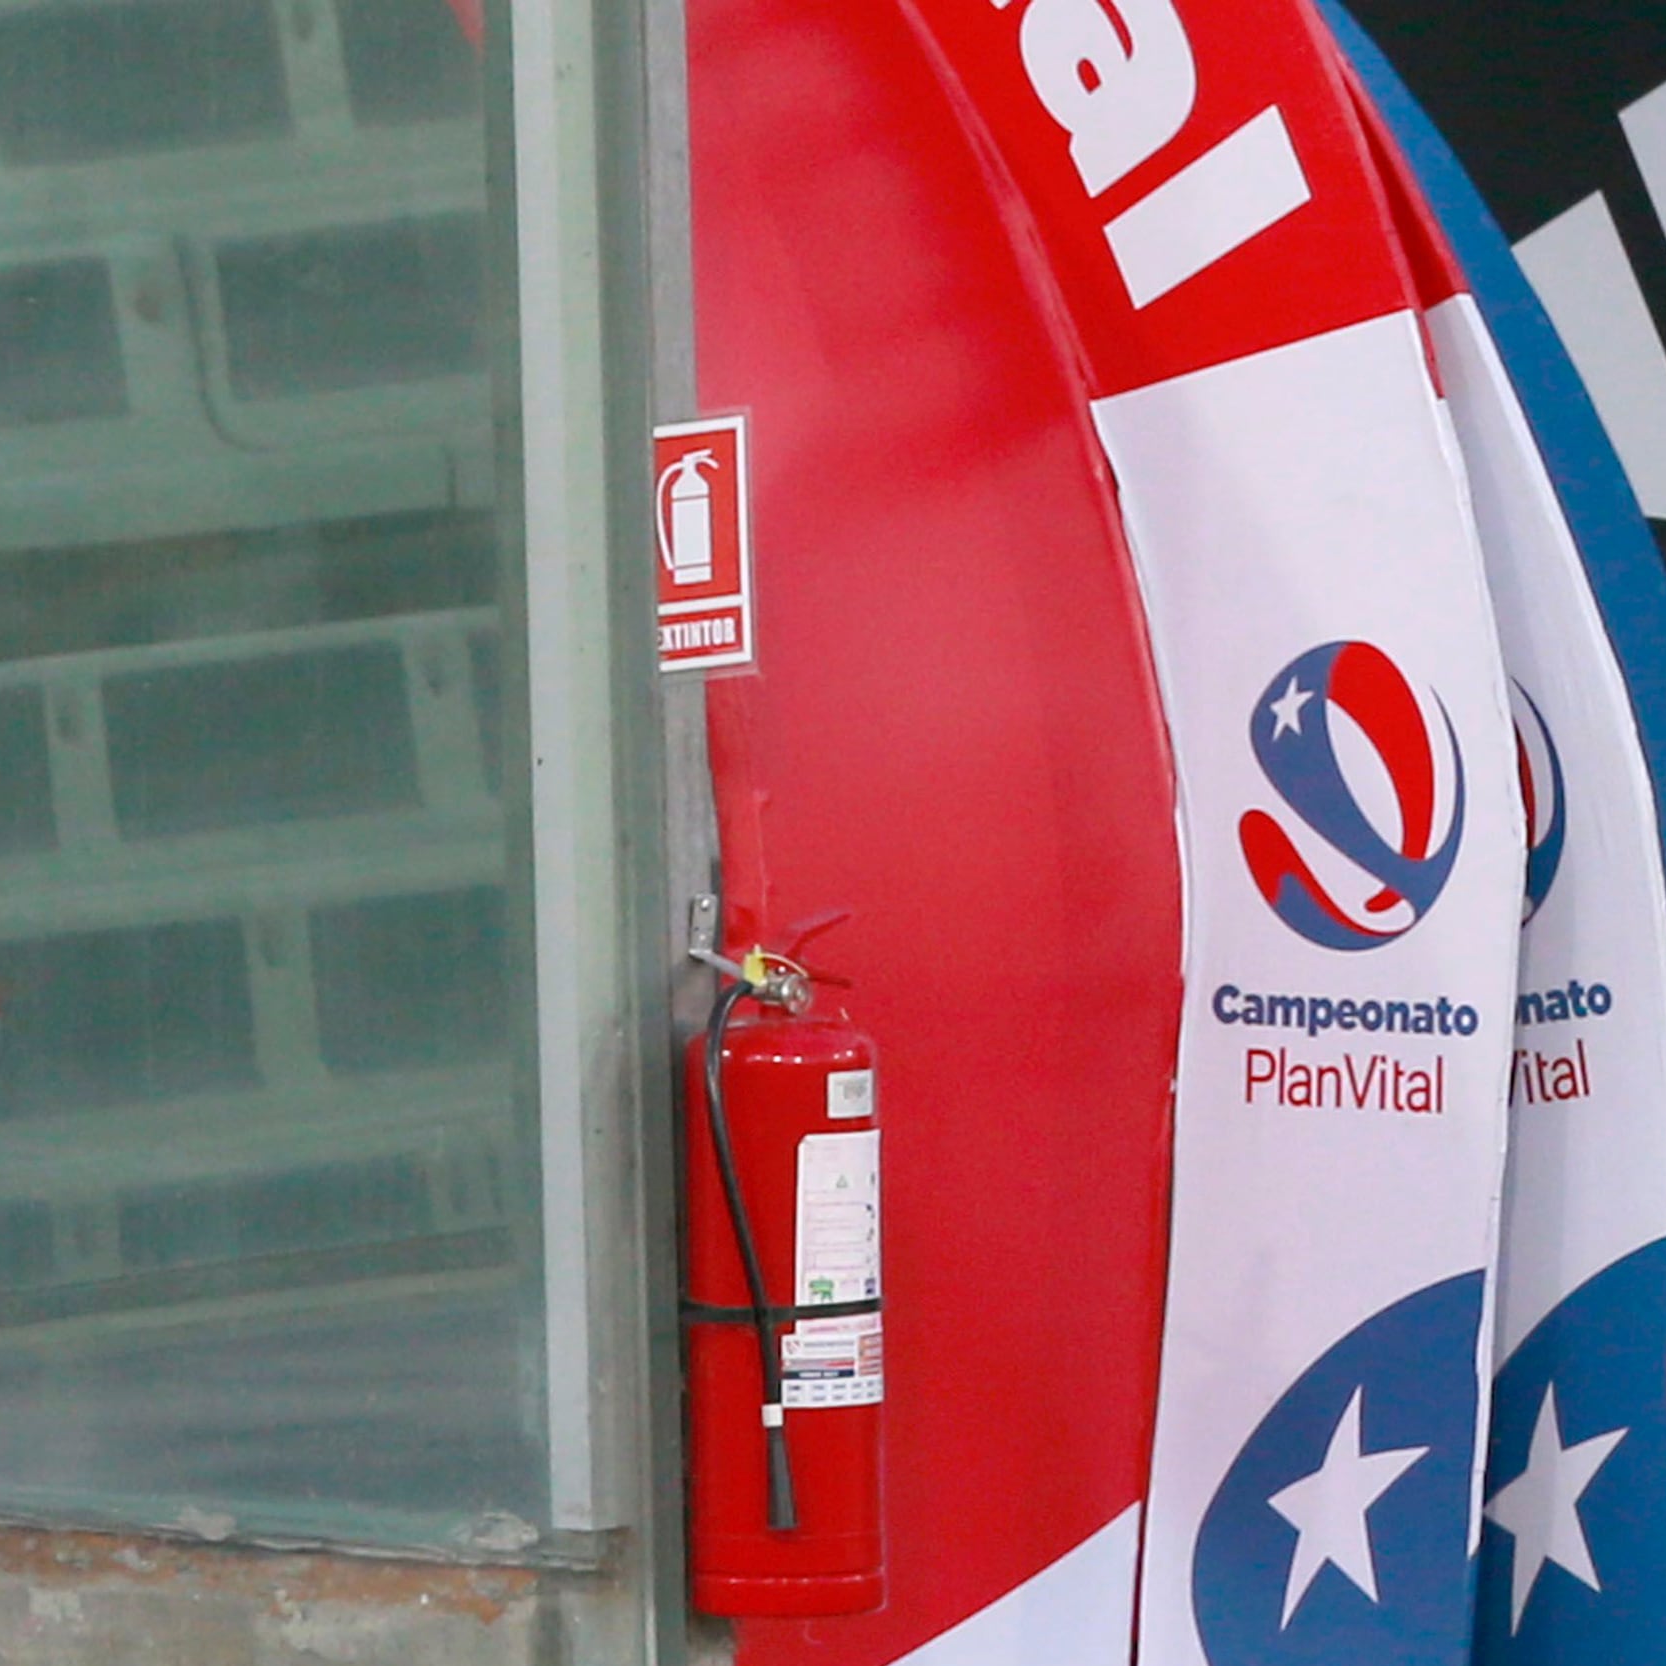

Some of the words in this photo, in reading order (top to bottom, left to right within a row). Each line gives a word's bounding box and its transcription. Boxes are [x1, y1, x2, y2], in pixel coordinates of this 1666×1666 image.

[991, 0, 1312, 310] al
[1212, 984, 1479, 1036] Campeonato
[1514, 980, 1612, 1024] nato
[1245, 1047, 1444, 1113] PlanVital
